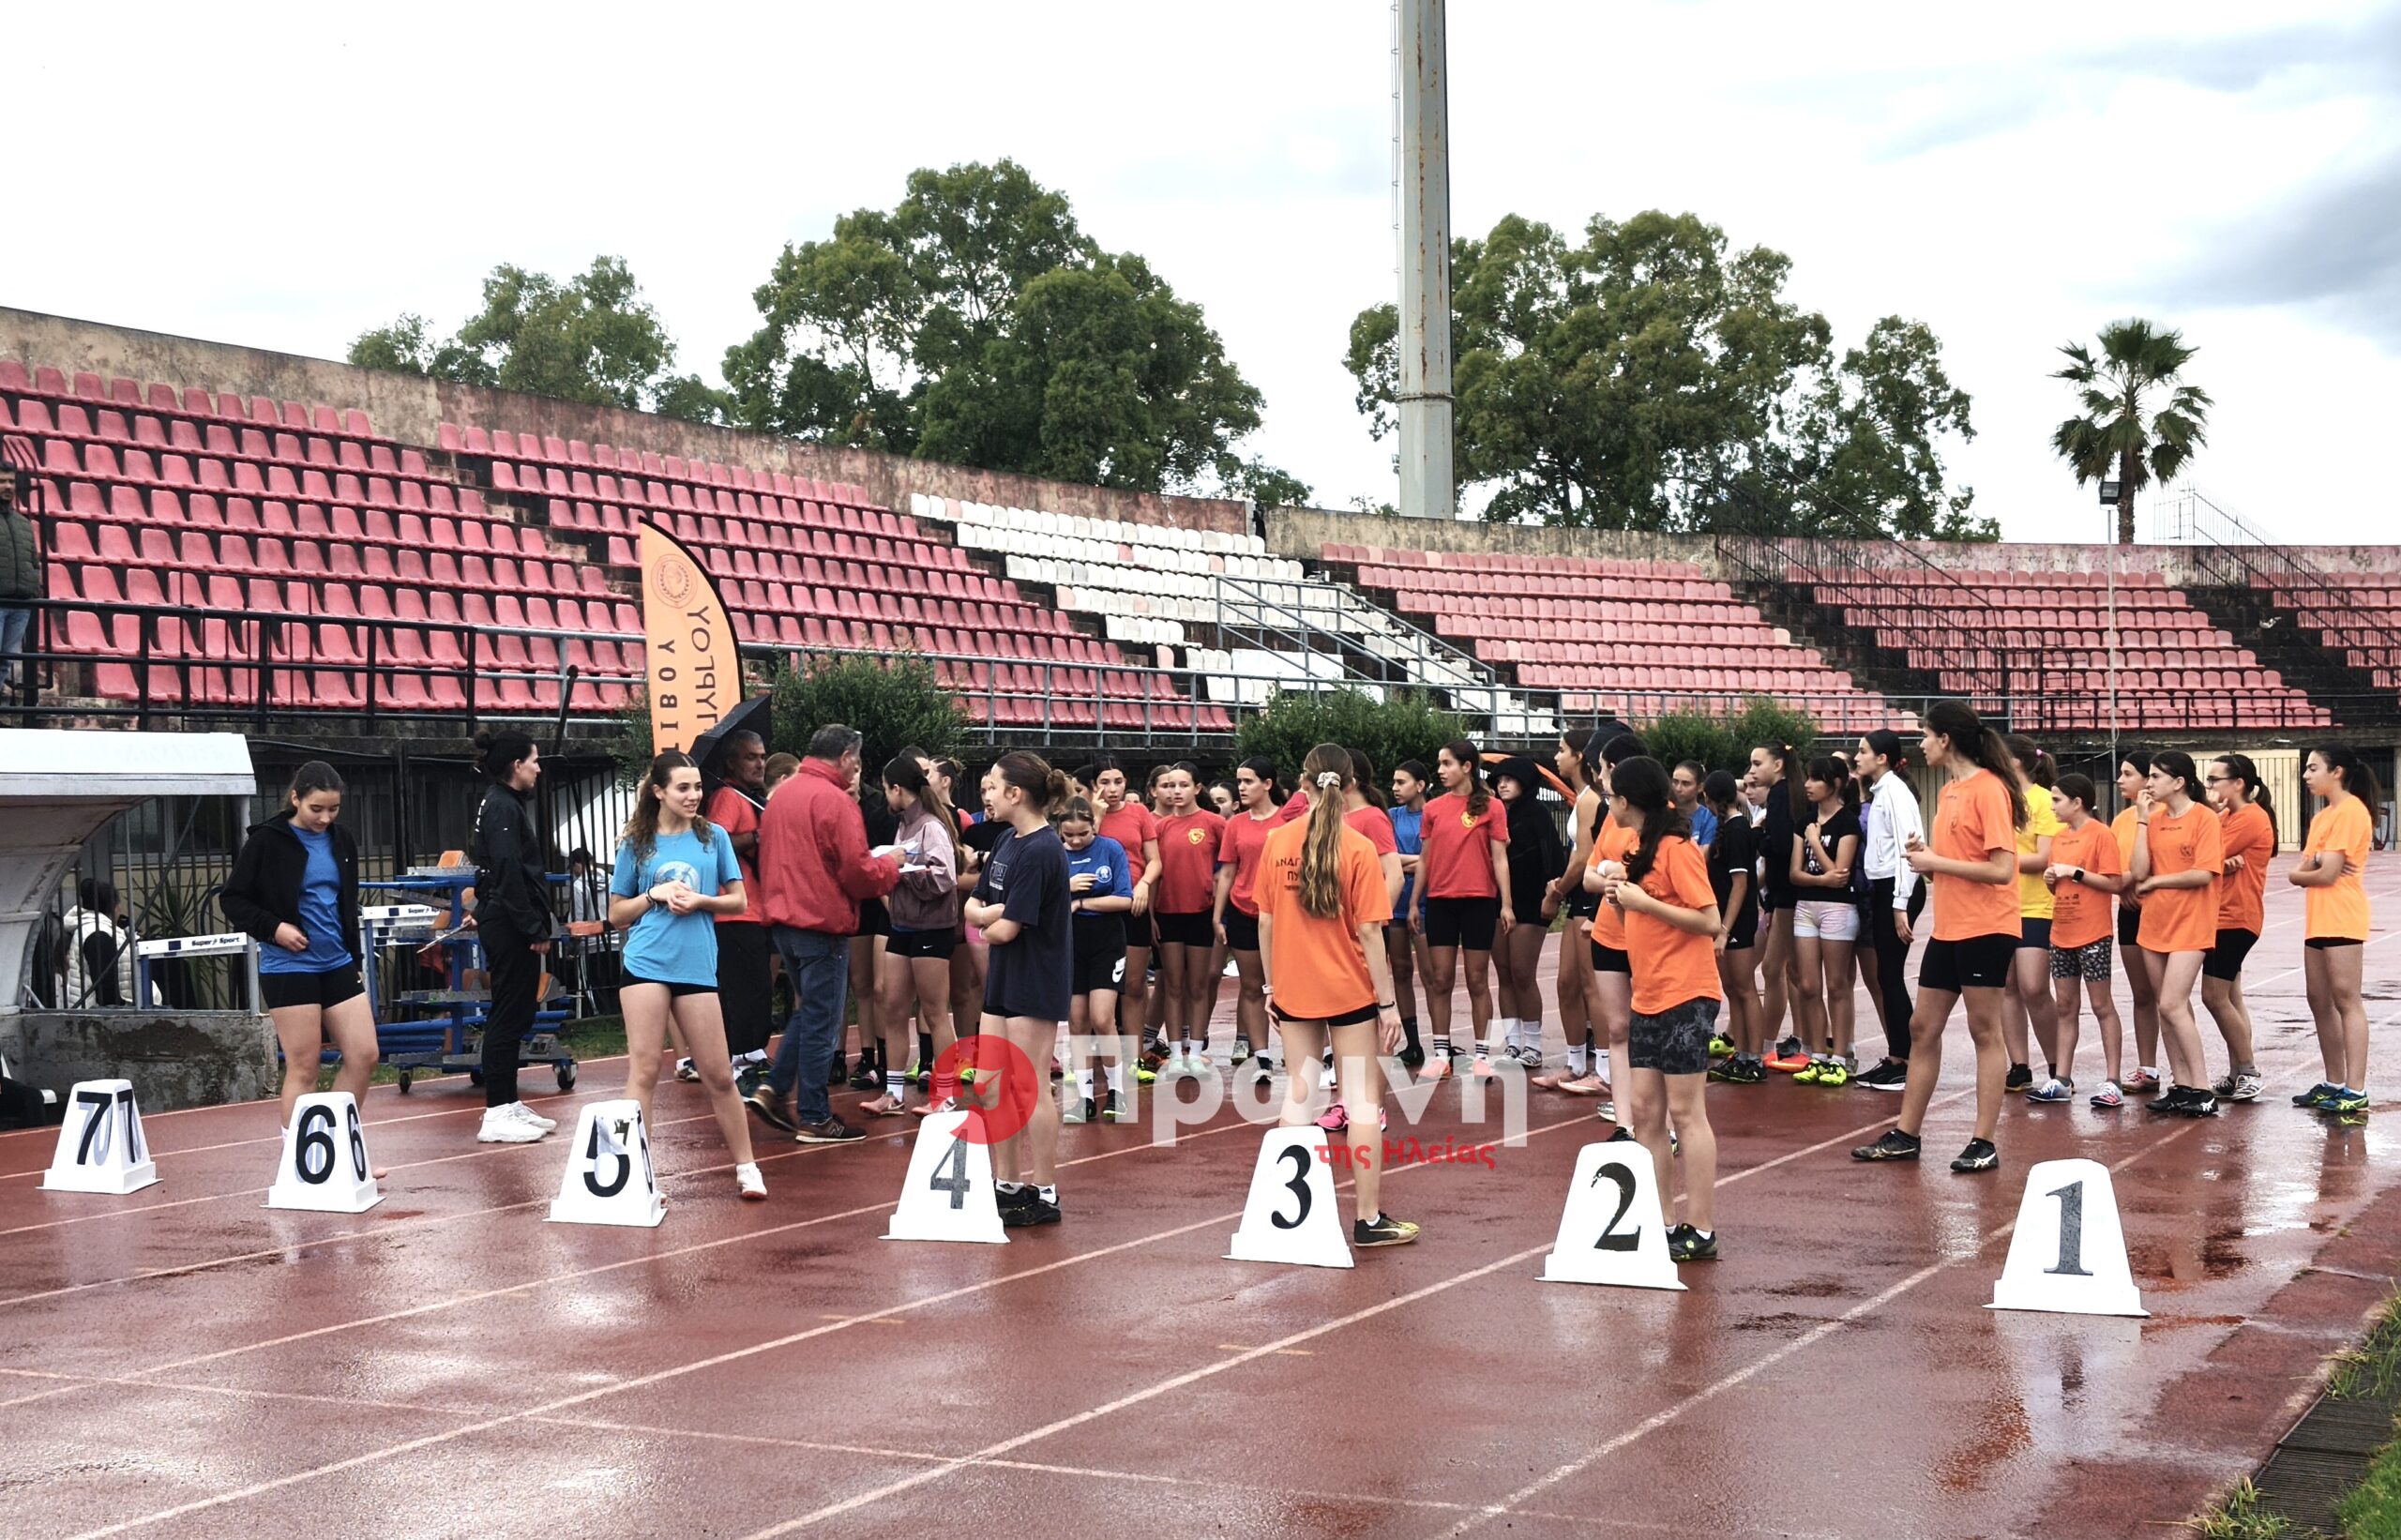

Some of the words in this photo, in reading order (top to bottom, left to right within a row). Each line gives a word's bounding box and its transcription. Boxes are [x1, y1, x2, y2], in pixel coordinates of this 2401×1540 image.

[77, 1091, 113, 1166] 7
[295, 1104, 337, 1185] 6
[347, 1103, 367, 1183] 6
[582, 1114, 631, 1198] 5
[929, 1128, 971, 1210] 4
[1271, 1144, 1312, 1230] 3
[1591, 1161, 1641, 1252] 2
[2043, 1180, 2094, 1276] 1
